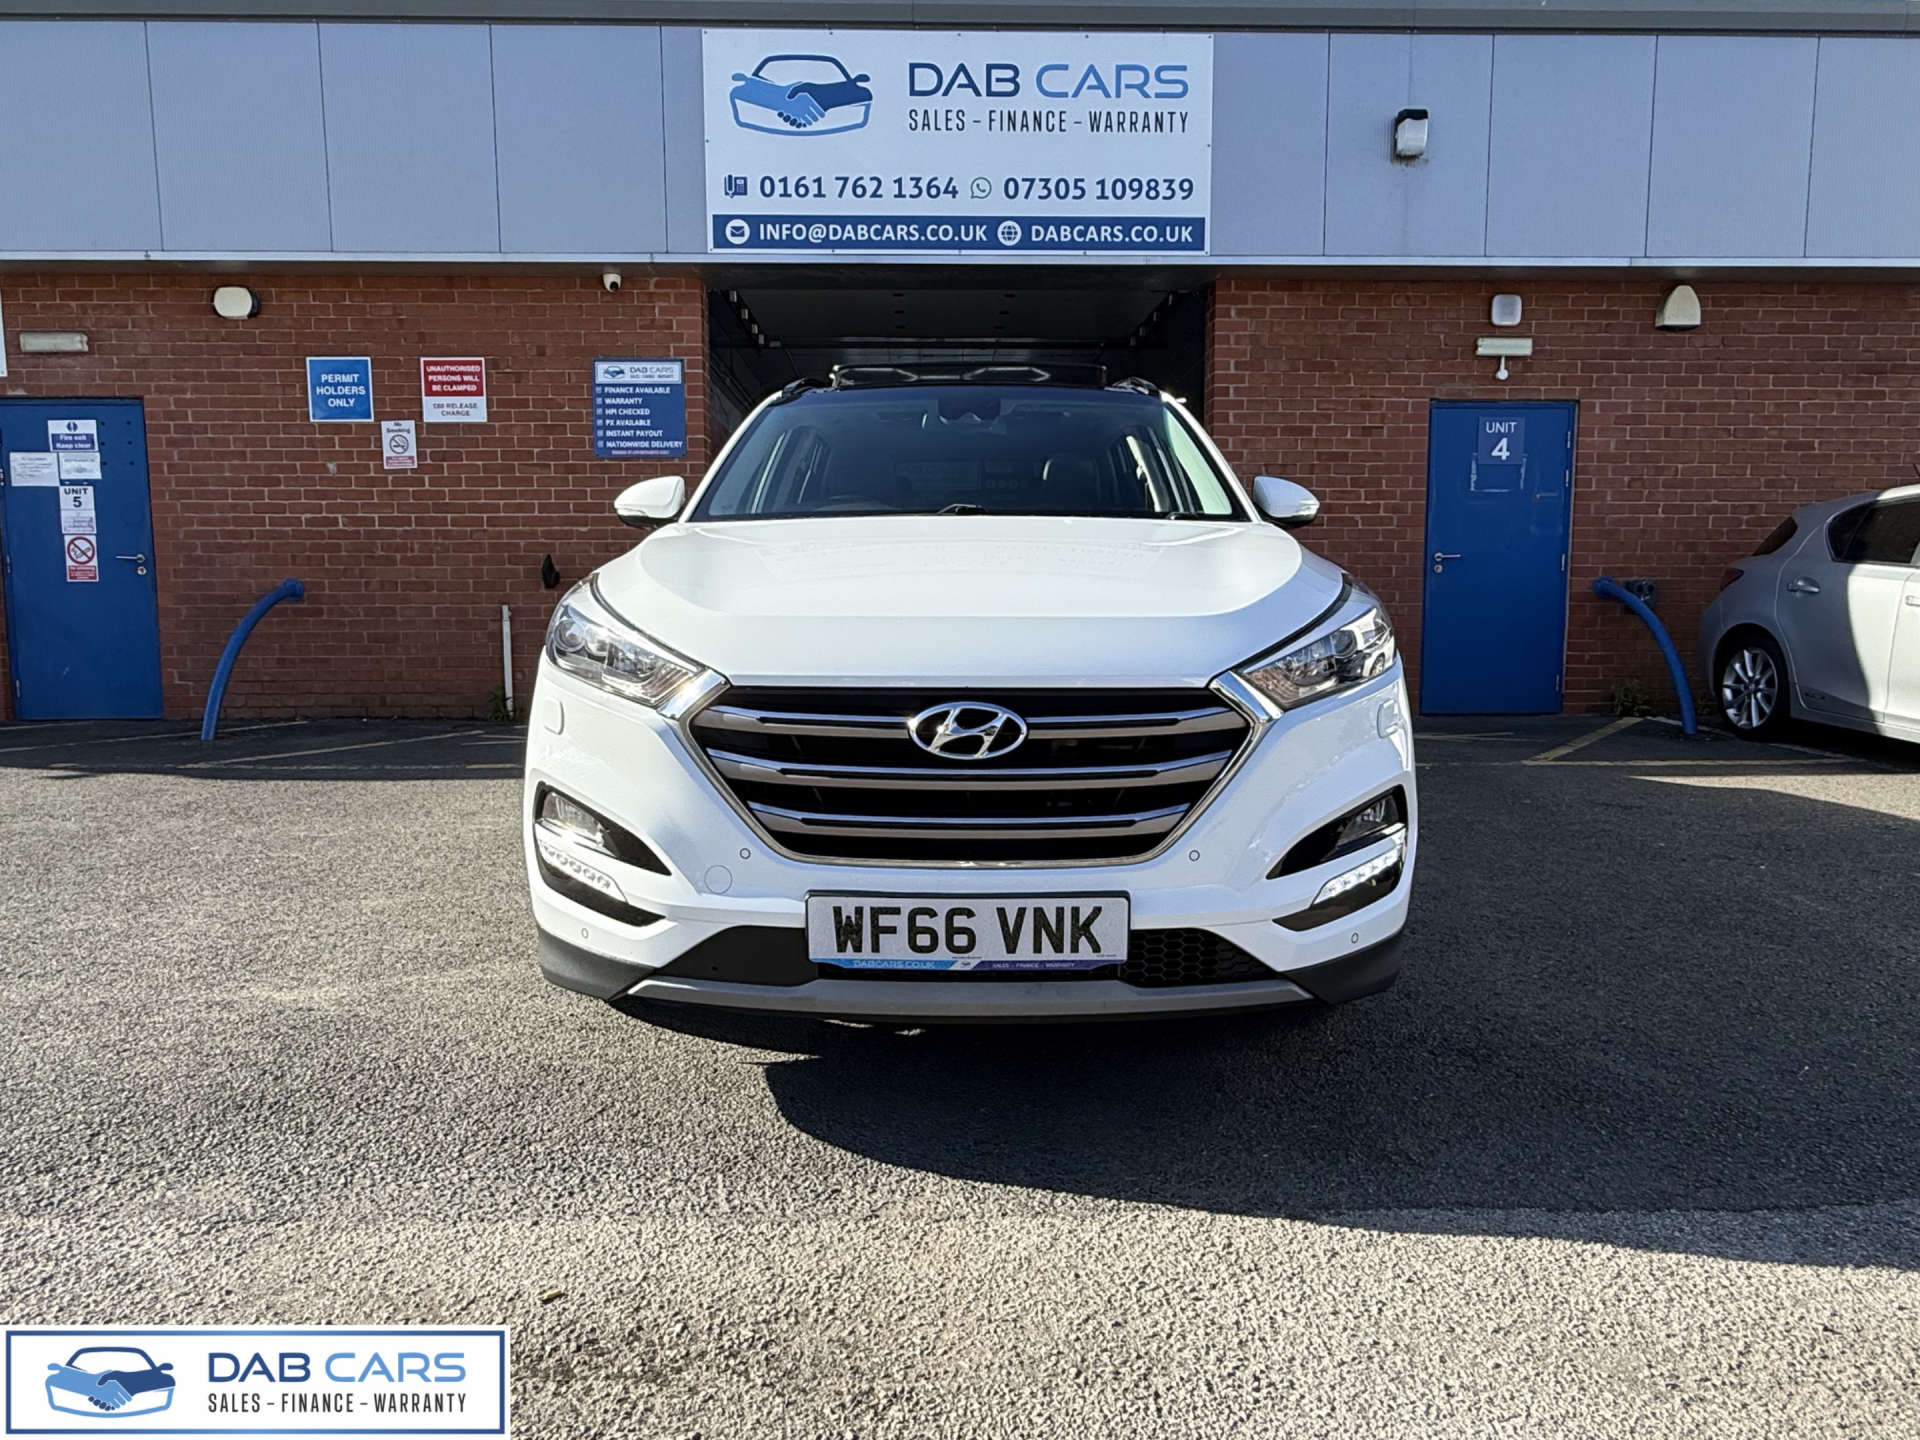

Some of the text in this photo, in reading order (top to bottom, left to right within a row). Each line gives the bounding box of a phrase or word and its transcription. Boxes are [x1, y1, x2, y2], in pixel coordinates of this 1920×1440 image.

[908, 62, 1189, 99] DAB CARS
[908, 109, 966, 132] SALES
[988, 110, 1067, 133] FINANCE
[1089, 111, 1189, 133] WARRANTY
[759, 175, 959, 200] 0161 762 1364
[1003, 177, 1194, 201] 07305 109839
[759, 223, 988, 242] INFO@DABCARS.CO.UK
[1031, 224, 1193, 243] DABCARS.CO.UK
[321, 374, 359, 383] PERMIT
[316, 386, 366, 395] HOLDERS
[327, 398, 356, 407] ONLY
[604, 397, 643, 405] WARRANTY
[1486, 422, 1517, 433] UNIT
[1491, 437, 1510, 460] 4
[73, 496, 82, 508] 5
[832, 905, 1103, 954] WF66 VNK
[853, 960, 936, 969] DABCARS.CO.UK
